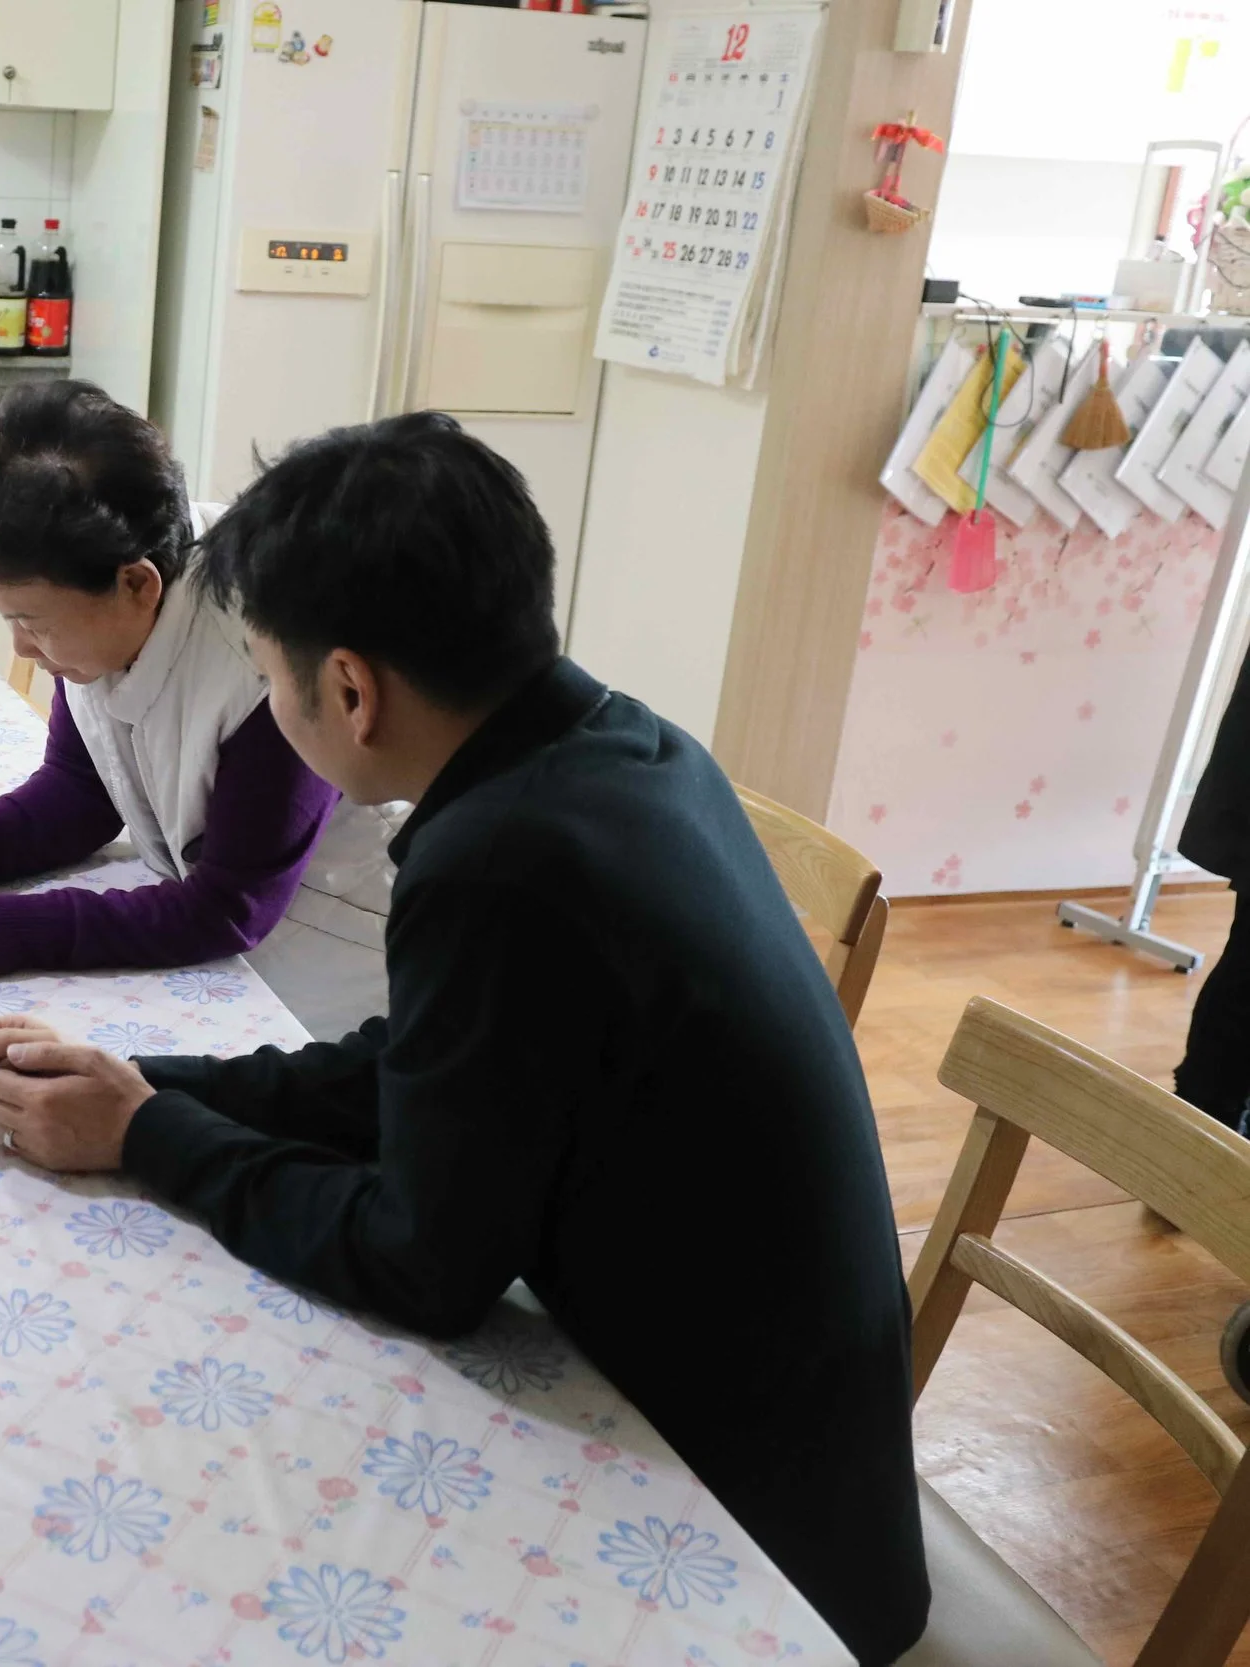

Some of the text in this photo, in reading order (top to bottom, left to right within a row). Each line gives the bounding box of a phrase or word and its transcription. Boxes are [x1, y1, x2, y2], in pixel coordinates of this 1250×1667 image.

[720, 23, 750, 62] 12
[656, 127, 775, 149] 2 3 4 5 6 7 8
[648, 164, 765, 189] 9 10 11 12 13 14 15
[635, 201, 758, 230] 16 17 18 19 20 21 22
[662, 241, 749, 269] 25 26 27 28 29
